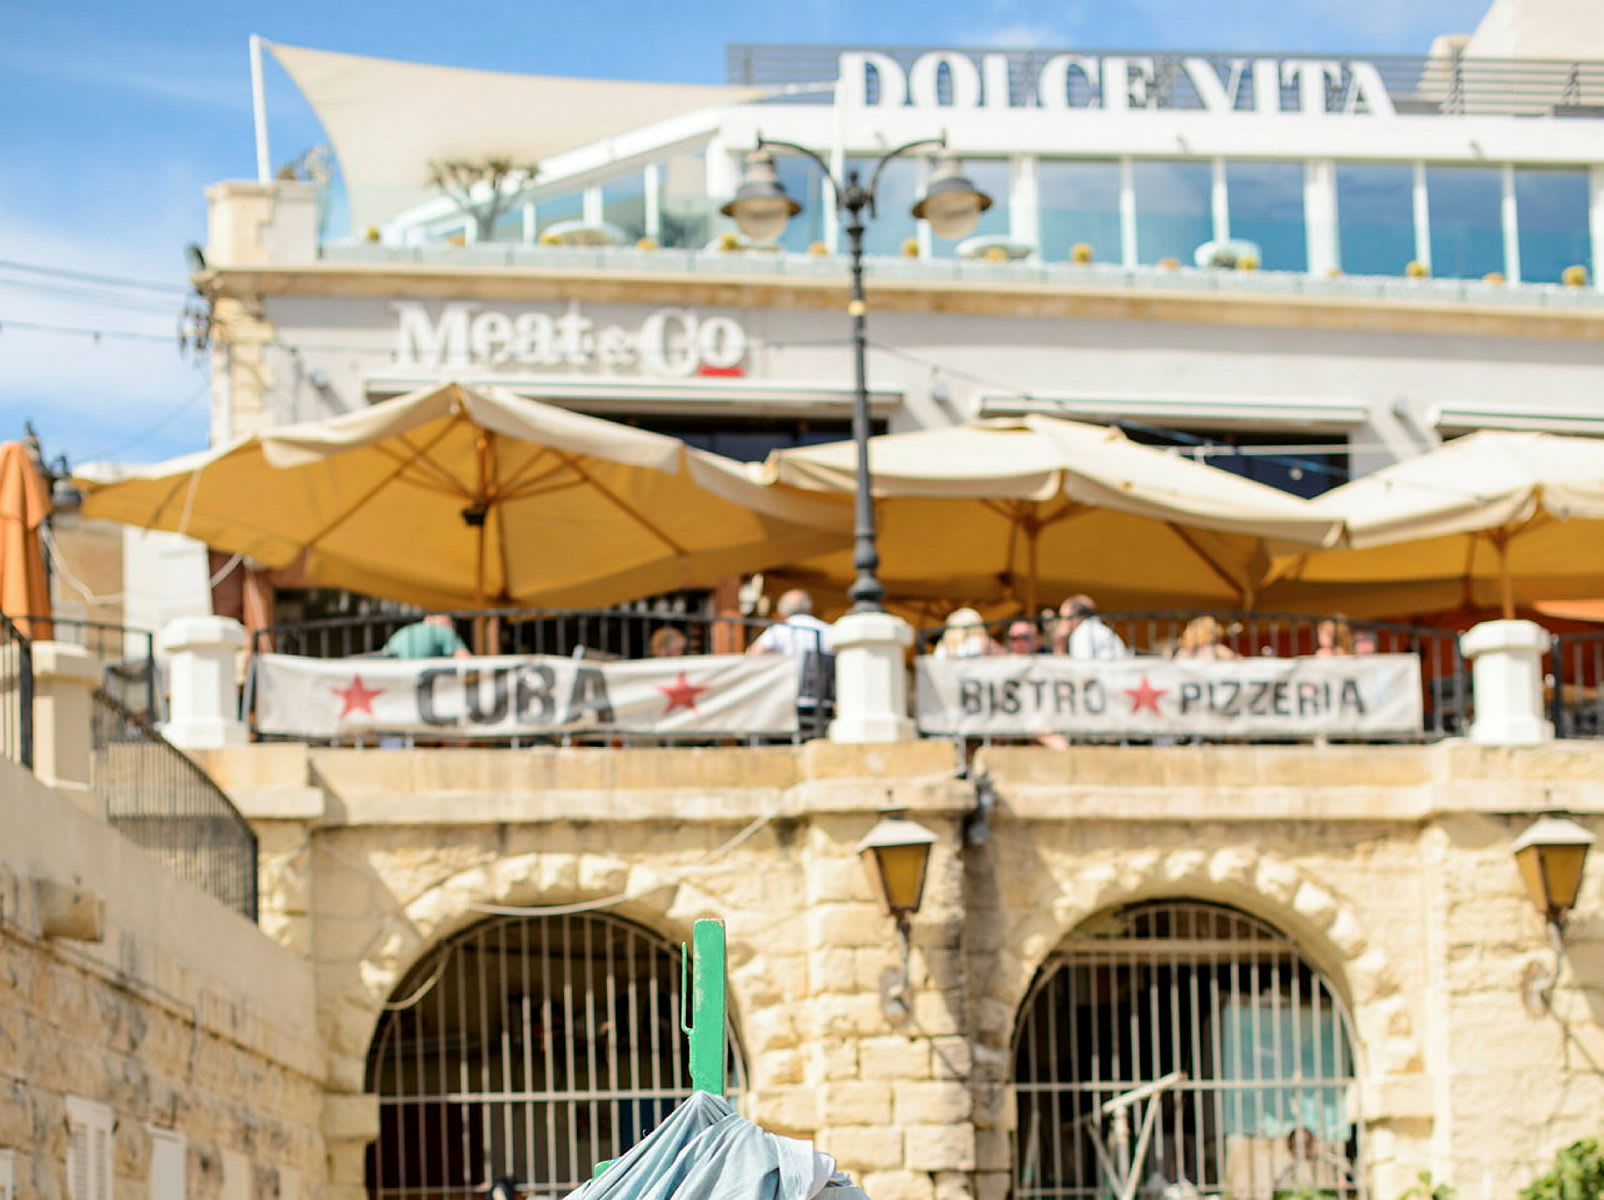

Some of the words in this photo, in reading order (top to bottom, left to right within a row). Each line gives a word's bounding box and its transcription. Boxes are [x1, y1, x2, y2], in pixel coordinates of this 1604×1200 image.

[838, 50, 1158, 111] DOLCE
[1183, 57, 1397, 117] VITA
[390, 299, 594, 370] Meat
[417, 665, 616, 727] CUBA
[960, 677, 1106, 717] BISTRO
[1179, 678, 1367, 717] PIZZERIA
